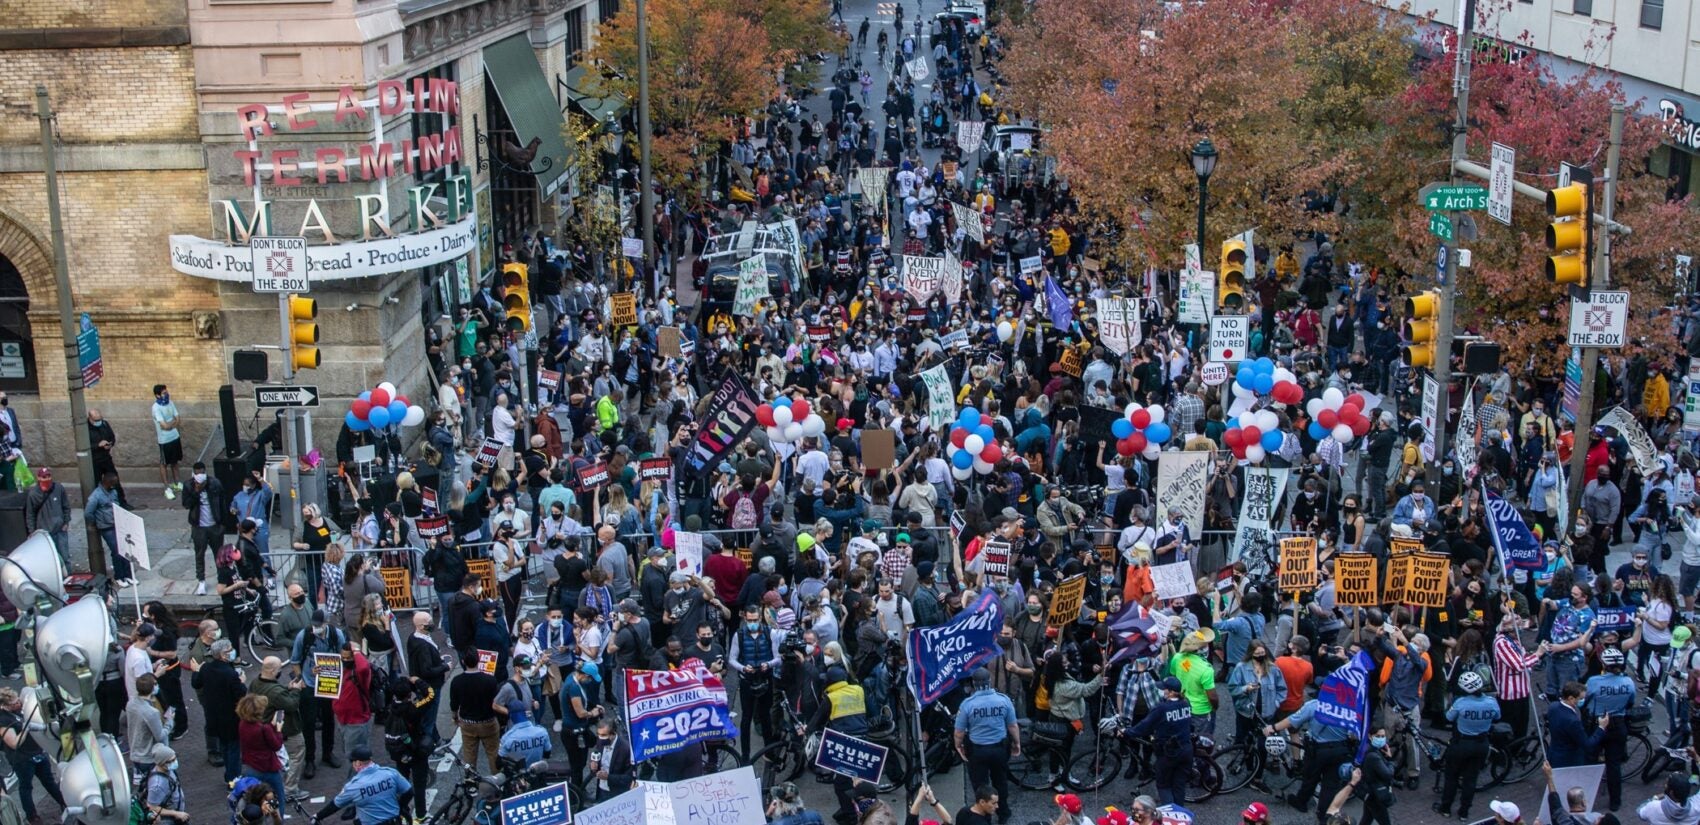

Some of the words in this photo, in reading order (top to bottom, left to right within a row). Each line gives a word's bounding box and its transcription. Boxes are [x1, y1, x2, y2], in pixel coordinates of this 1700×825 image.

[237, 77, 460, 142] READING
[234, 125, 463, 187] TERMINA
[286, 186, 328, 197] STREET
[1444, 195, 1473, 208] Arch
[278, 239, 303, 250] BLOCK
[175, 246, 213, 269] Seafood
[367, 246, 430, 267] Produce
[441, 233, 468, 254] Dairy
[906, 257, 941, 269] COUNT
[909, 267, 939, 278] EVERY
[257, 280, 277, 290] THE
[283, 280, 304, 290] BOX
[907, 273, 938, 292] VOTE
[1599, 294, 1625, 304] BLOCK
[616, 307, 631, 315] OUT
[614, 314, 636, 324] NOW!
[1220, 319, 1238, 329] NO
[1216, 330, 1242, 338] TURN
[1572, 333, 1593, 344] THE
[1597, 333, 1620, 344] BOX
[1228, 339, 1245, 347] RED
[1065, 355, 1080, 366] OUT
[1060, 361, 1081, 376] NOW!
[1203, 367, 1226, 375] UNITE
[1203, 373, 1226, 381] HERE!
[262, 393, 279, 401] ONE
[281, 392, 299, 401] WAY
[478, 453, 497, 464] VOTE
[642, 467, 669, 477] CONCEDE
[582, 471, 609, 486] CONCEDE
[419, 524, 448, 536] CONCEDE
[1283, 539, 1313, 550] Trump/
[986, 546, 1008, 556] COUNT
[1285, 548, 1311, 557] Pence
[1511, 549, 1538, 559] GREAT!
[983, 561, 1007, 573] VOTE
[1286, 558, 1309, 571] OUT
[1338, 558, 1373, 569] Trump/
[1412, 558, 1446, 569] Trump/
[381, 571, 405, 579] rump/
[1341, 568, 1371, 577] Pence
[1413, 567, 1443, 577] Pence
[1281, 572, 1314, 586] NOW!
[1342, 578, 1369, 590] OUT
[1391, 575, 1407, 588] OU
[1413, 577, 1441, 591] OUT
[387, 597, 410, 607] OW!
[1336, 591, 1374, 604] NOW!
[1406, 590, 1443, 605] NOW!
[1056, 598, 1078, 613] OUT
[1048, 607, 1080, 626] NOW!
[1600, 684, 1631, 698] POLICE
[636, 698, 664, 714] KEEP
[973, 706, 1004, 719] POLICE
[1464, 709, 1494, 721] POLICE
[514, 736, 545, 752] POLICE
[643, 748, 655, 756] FOR
[825, 738, 881, 763] TRUMP
[828, 750, 874, 769] PENCE
[359, 778, 394, 800] POLICE
[675, 779, 713, 800] STOP
[703, 788, 741, 802] STEAL
[506, 794, 565, 818] TRUMP
[578, 798, 639, 825] Democracy
[688, 796, 751, 821] AUDIT
[512, 805, 561, 824] PENCE
[707, 810, 742, 825] NOW
